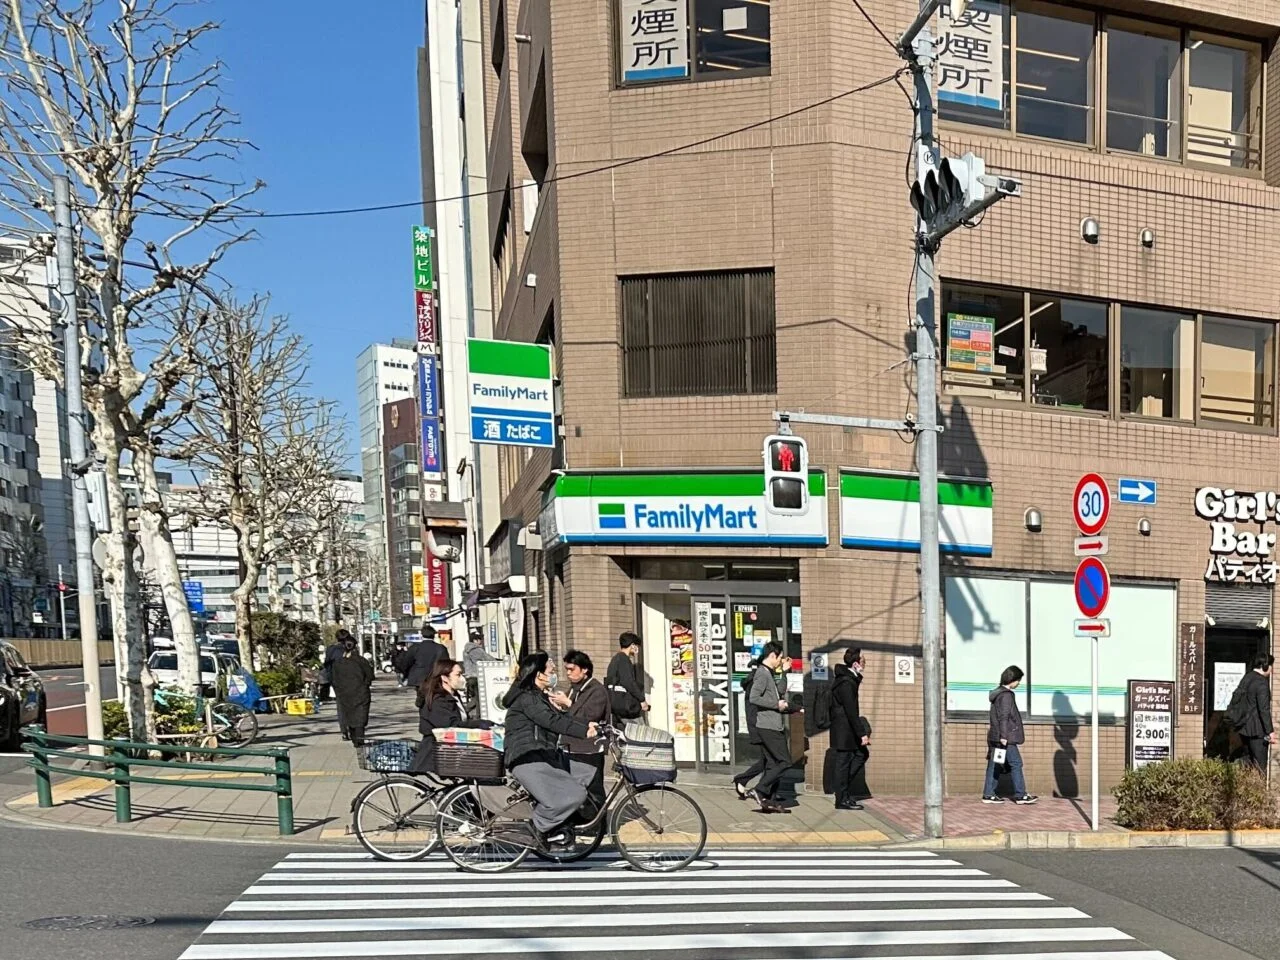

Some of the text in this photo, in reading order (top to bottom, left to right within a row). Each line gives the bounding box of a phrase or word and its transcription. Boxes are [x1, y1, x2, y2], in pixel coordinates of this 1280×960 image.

[631, 0, 679, 67] 煙所
[473, 383, 549, 401] FamilyMart
[483, 420, 542, 440] 酒 たばこ
[634, 503, 758, 532] FamilyMart
[1081, 490, 1101, 518] 30
[1210, 521, 1276, 555] Bar
